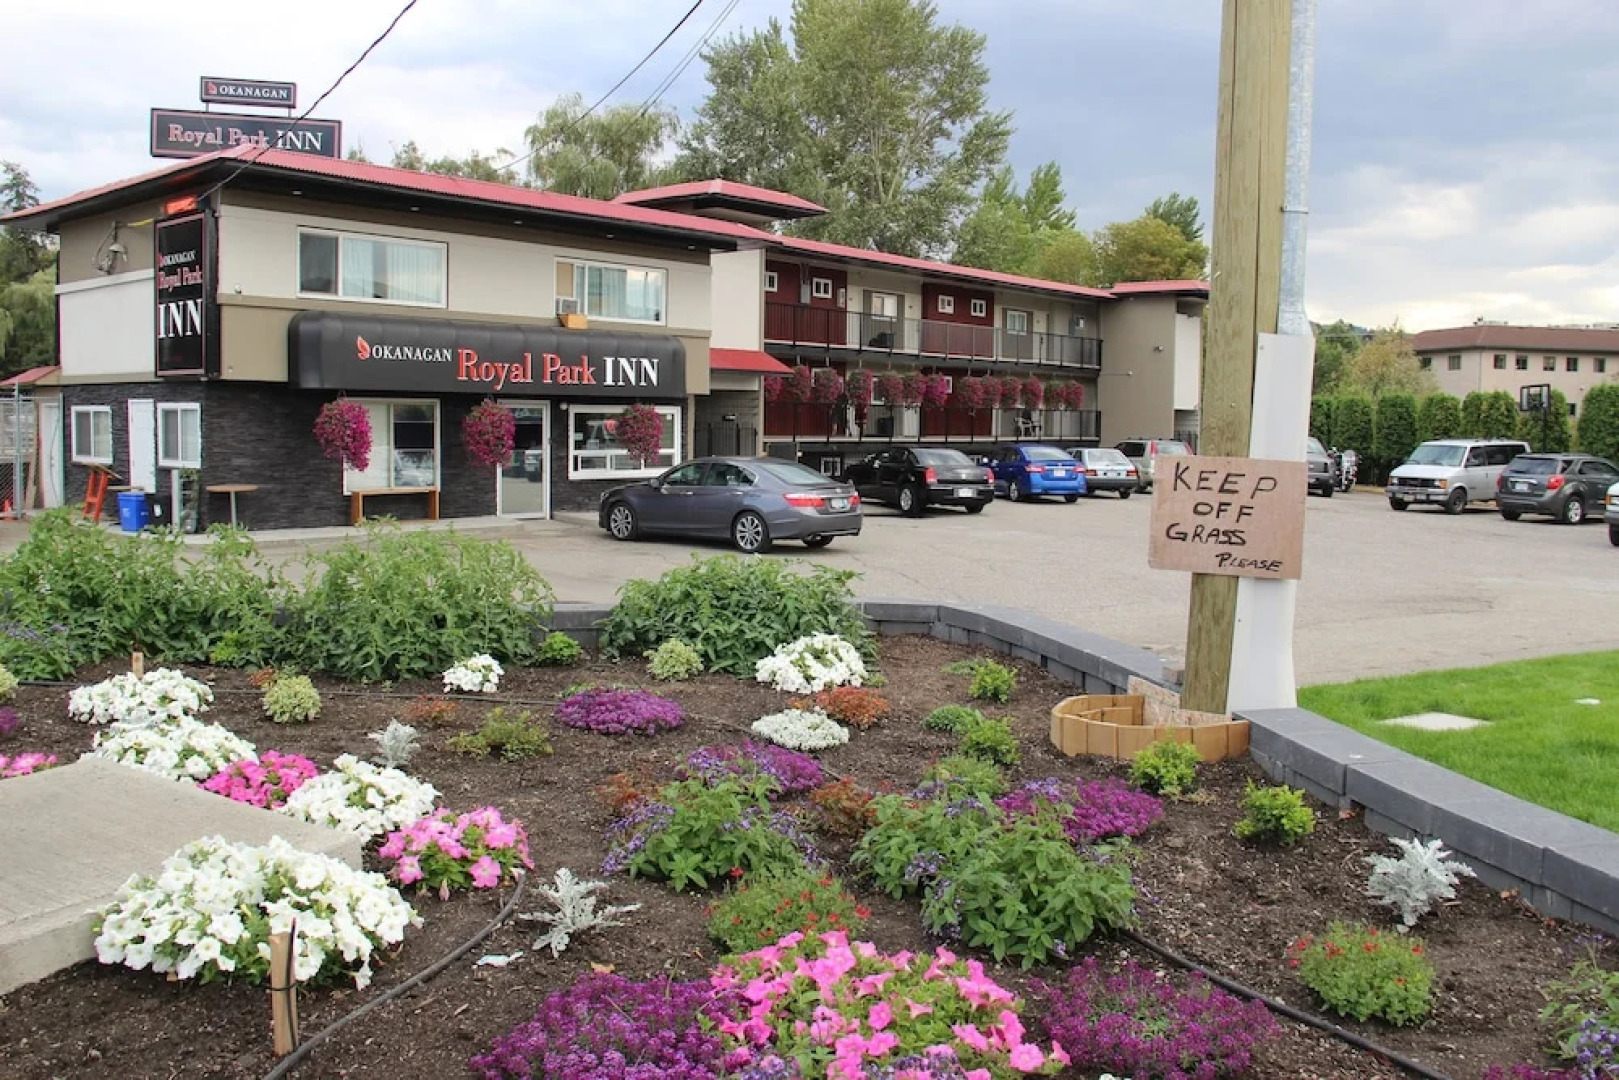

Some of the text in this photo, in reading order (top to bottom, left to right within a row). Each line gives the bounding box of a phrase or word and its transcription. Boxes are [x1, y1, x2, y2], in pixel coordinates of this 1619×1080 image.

[219, 85, 288, 98] OKANAGAN
[168, 124, 323, 150] Royal Park INN
[158, 298, 203, 339] INN
[372, 344, 660, 391] OKANAGAN Royal Park INN
[1173, 461, 1278, 500] KEEP
[1192, 501, 1254, 523] OFF
[1165, 522, 1247, 546] GRASS
[1215, 551, 1283, 572] PLEASE
